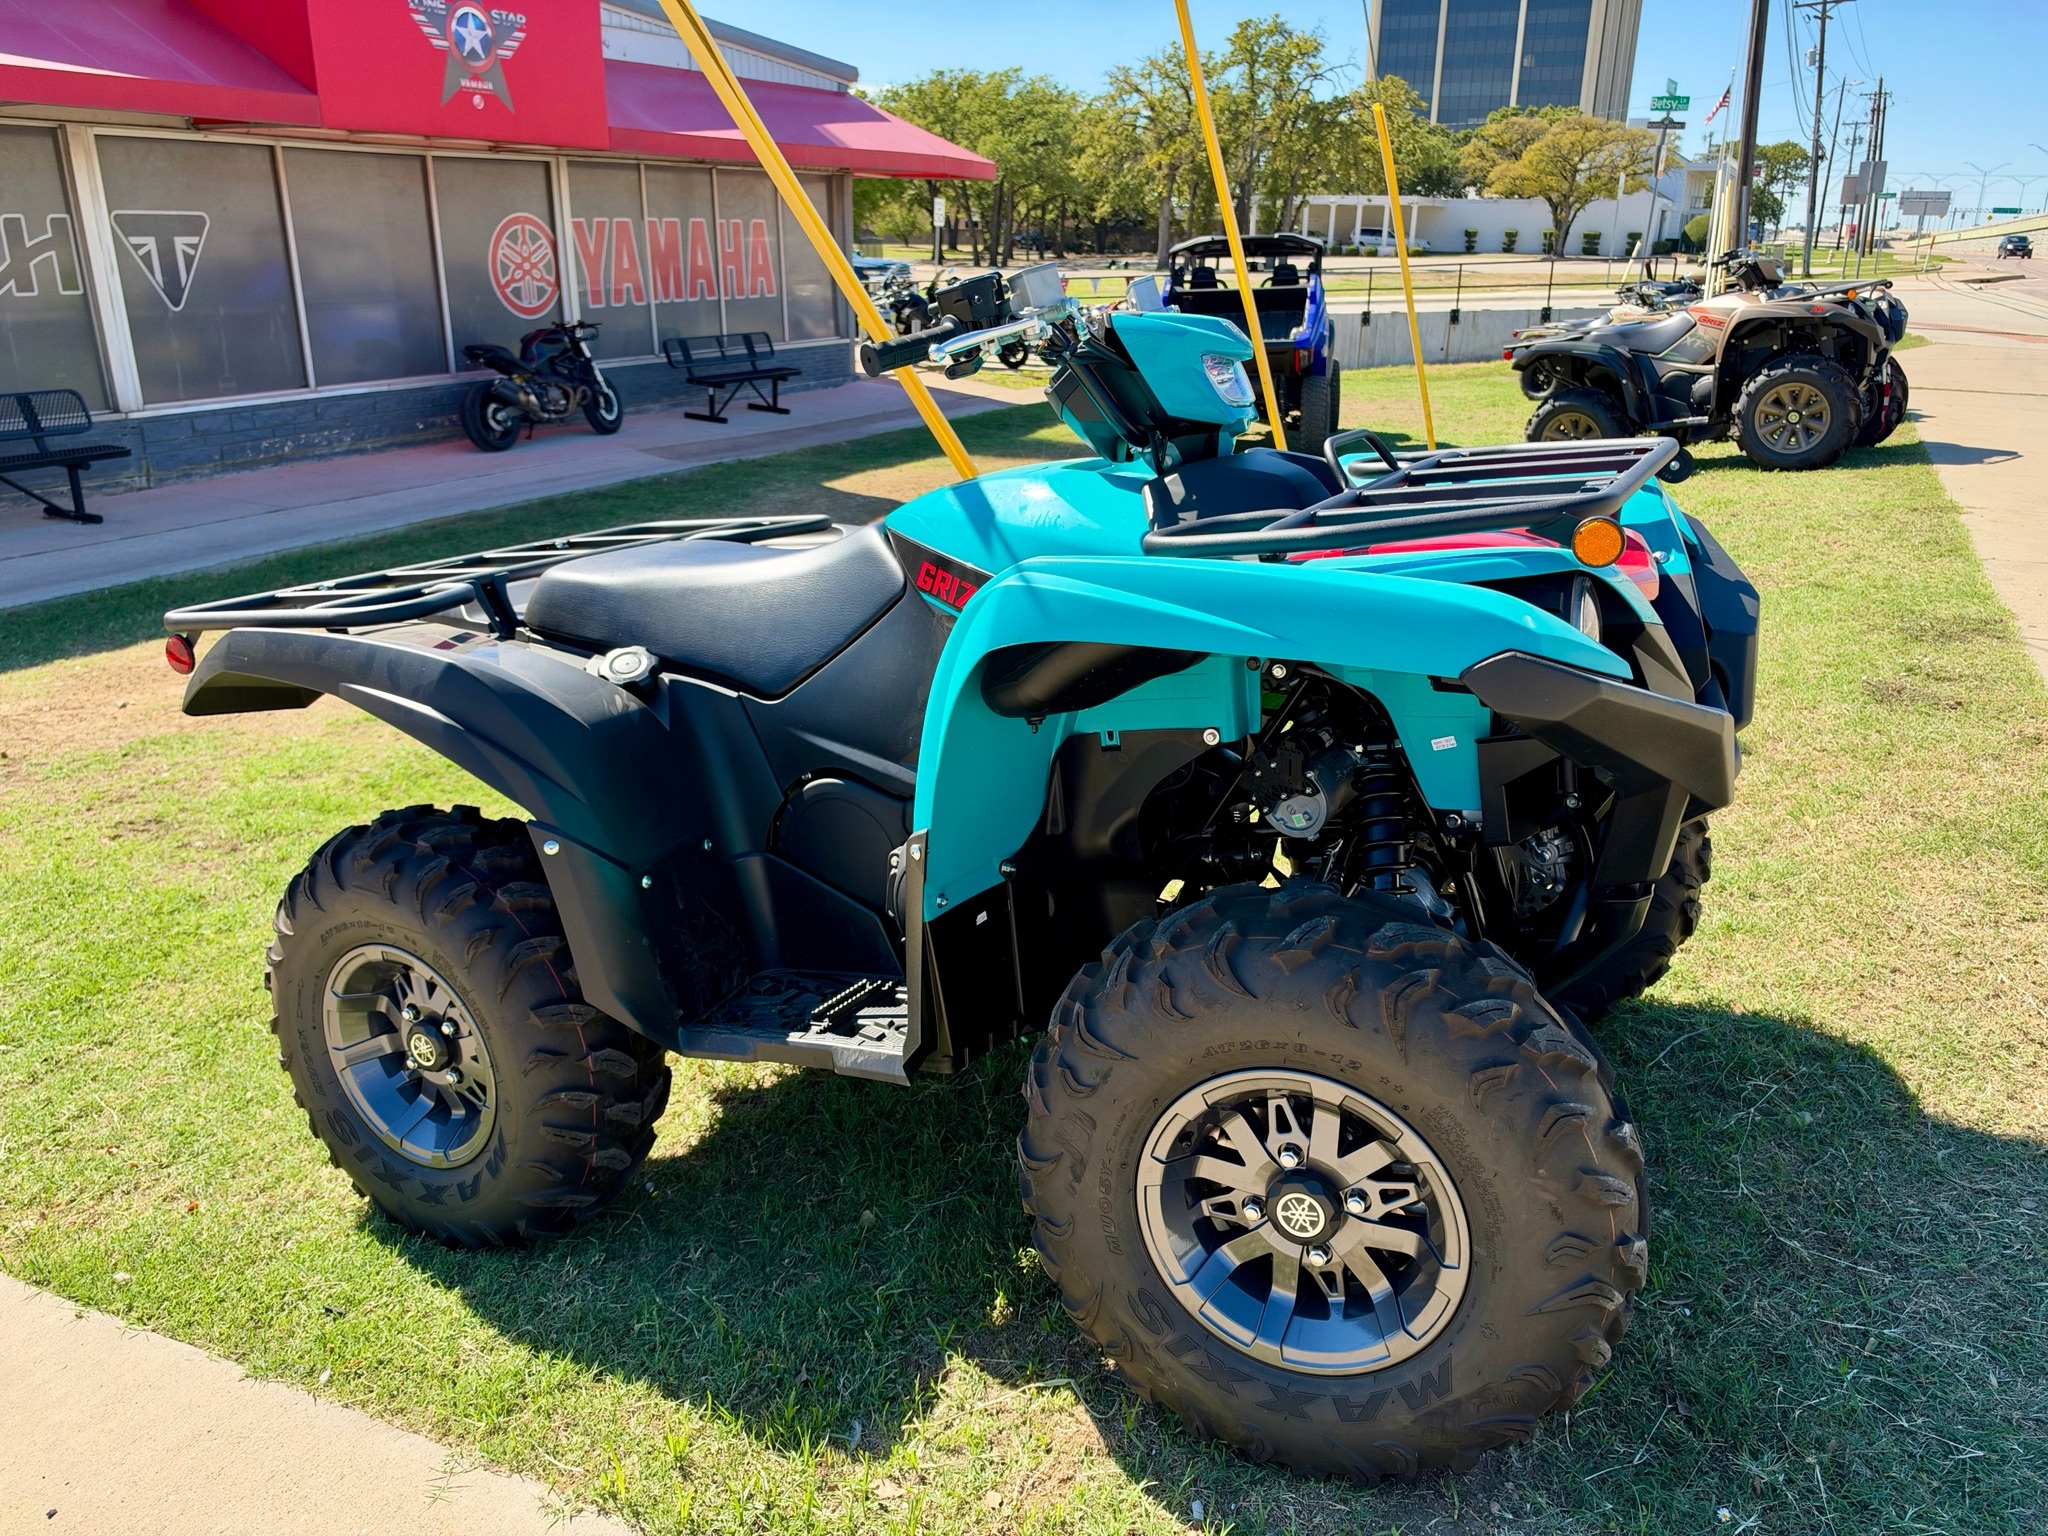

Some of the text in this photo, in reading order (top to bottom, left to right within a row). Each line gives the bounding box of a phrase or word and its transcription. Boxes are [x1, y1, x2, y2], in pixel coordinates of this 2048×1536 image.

[490, 9, 526, 28] STAR
[1651, 97, 1678, 111] Betsy
[571, 217, 777, 309] YAMAHA
[916, 561, 978, 609] GRIZ
[326, 1107, 508, 1206] MAXXIS
[1126, 1287, 1453, 1423] MAXXIS
